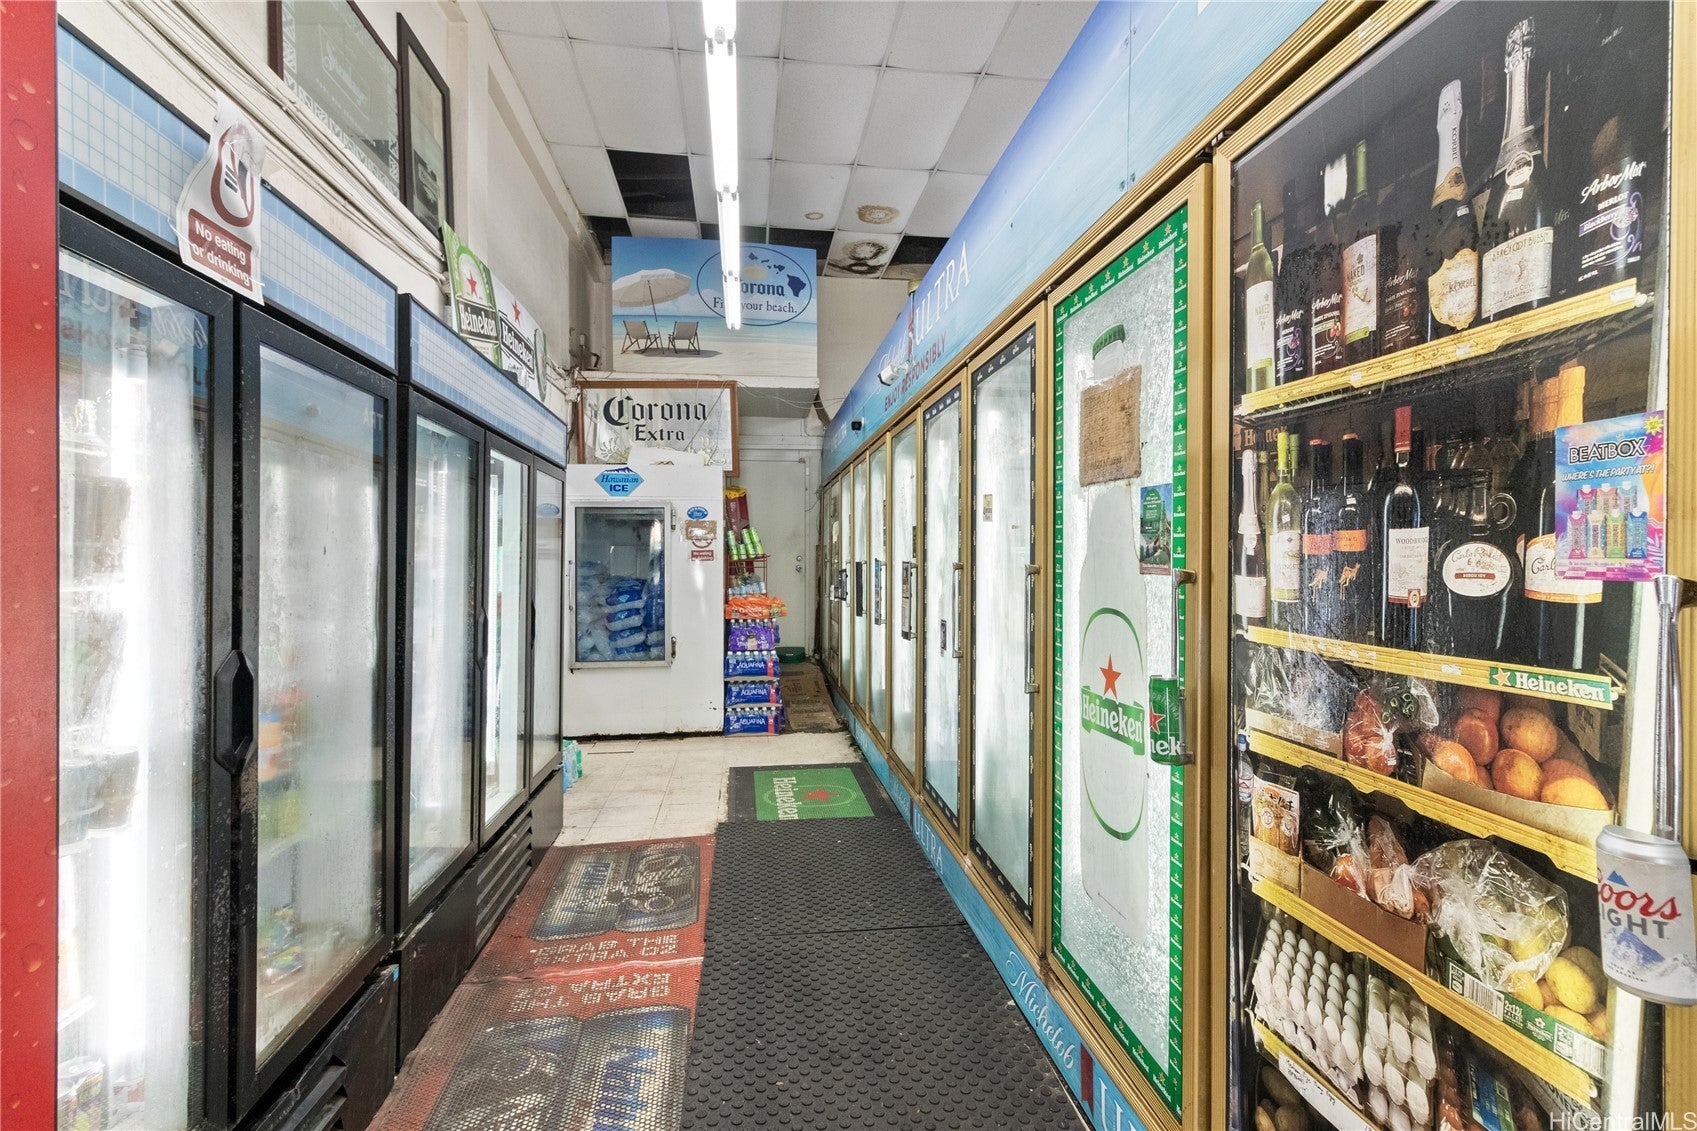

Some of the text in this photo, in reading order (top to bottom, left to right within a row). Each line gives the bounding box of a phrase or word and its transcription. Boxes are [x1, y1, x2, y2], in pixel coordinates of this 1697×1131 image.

[1598, 191, 1629, 211] MERLOT
[195, 220, 246, 266] No eating
[192, 243, 251, 287] or drinking
[741, 281, 785, 297] orona
[914, 240, 971, 346] ULTRA
[459, 302, 498, 338] Heineken
[741, 302, 763, 313] your
[766, 301, 798, 314] beach.
[501, 320, 534, 372] Heineken
[901, 331, 947, 394] RESPONSIBLY
[603, 395, 708, 428] Corona
[635, 423, 685, 442] Extra
[1568, 437, 1646, 464] BEATBOX
[609, 484, 629, 492] ICE
[1561, 469, 1595, 482] WHERE'S
[1595, 467, 1610, 478] THE
[1608, 465, 1636, 478] PARTY
[1532, 557, 1555, 575] Carl
[738, 660, 765, 669] AQUAFINA
[741, 688, 768, 697] AQUAFINA
[1515, 671, 1606, 702] Heineken
[739, 716, 766, 726] AQUAFINA
[1082, 693, 1143, 744] Heineken
[773, 776, 799, 821] Heineken
[914, 806, 944, 875] ULTRA
[1602, 903, 1670, 940] IGHT
[1005, 951, 1076, 1069] Michelob
